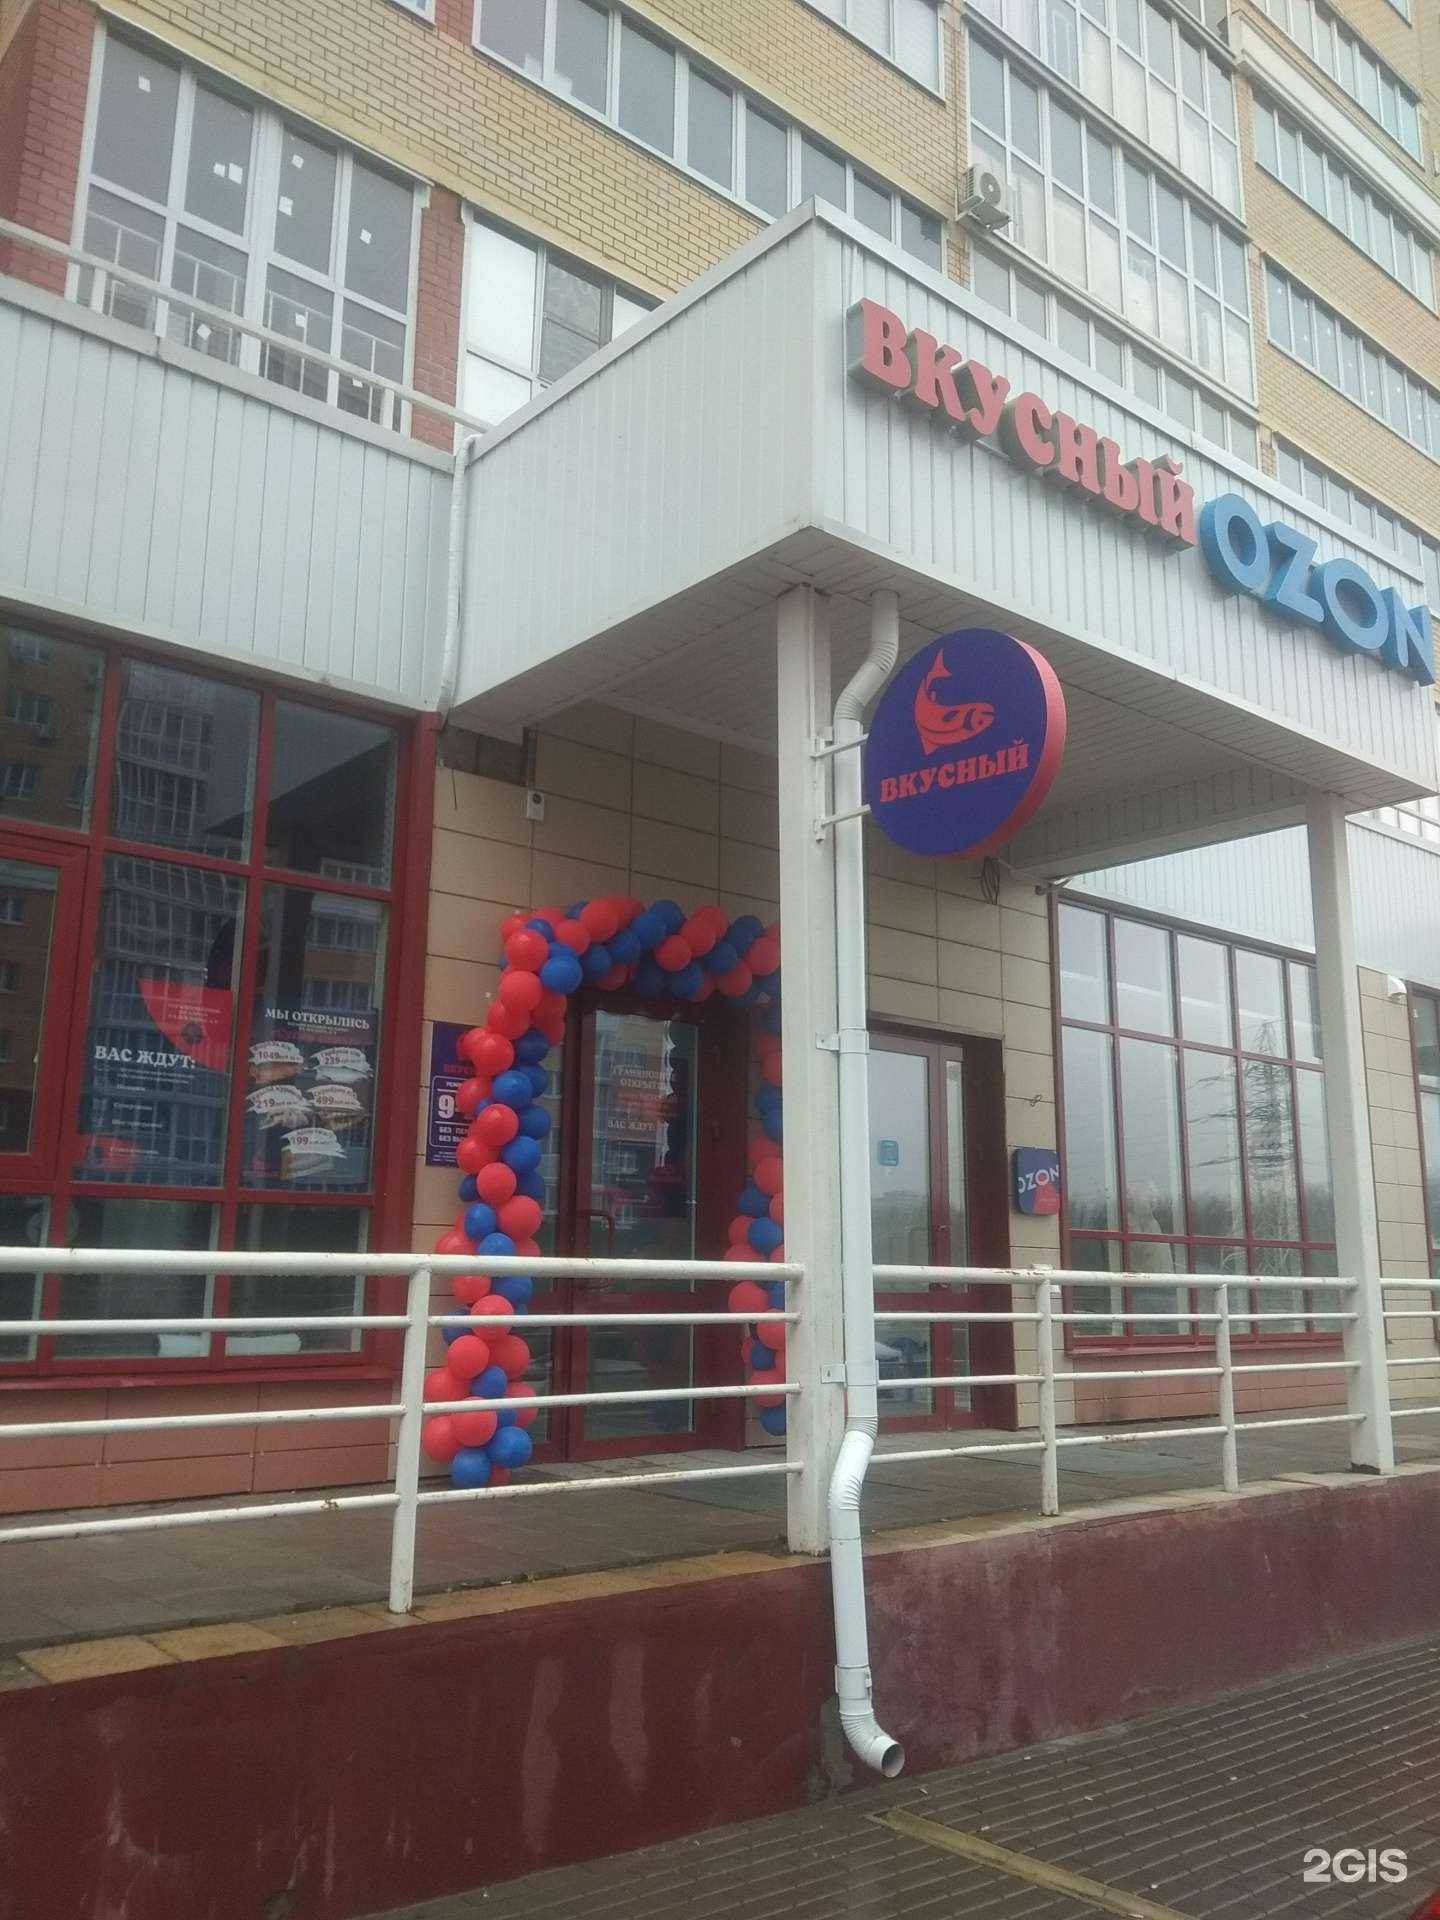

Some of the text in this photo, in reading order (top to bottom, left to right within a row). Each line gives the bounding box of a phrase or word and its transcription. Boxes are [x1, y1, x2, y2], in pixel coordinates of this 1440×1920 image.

[856, 298, 1197, 550] ВКУСНЫЙ
[1201, 493, 1436, 687] OZON
[880, 737, 1029, 802] ВКУСНЫЙ
[265, 1008, 289, 1020] МЫ
[292, 1011, 370, 1029] ОТКРЫЛИСЬ
[94, 1045, 196, 1069] ВАС ЖДУТ:
